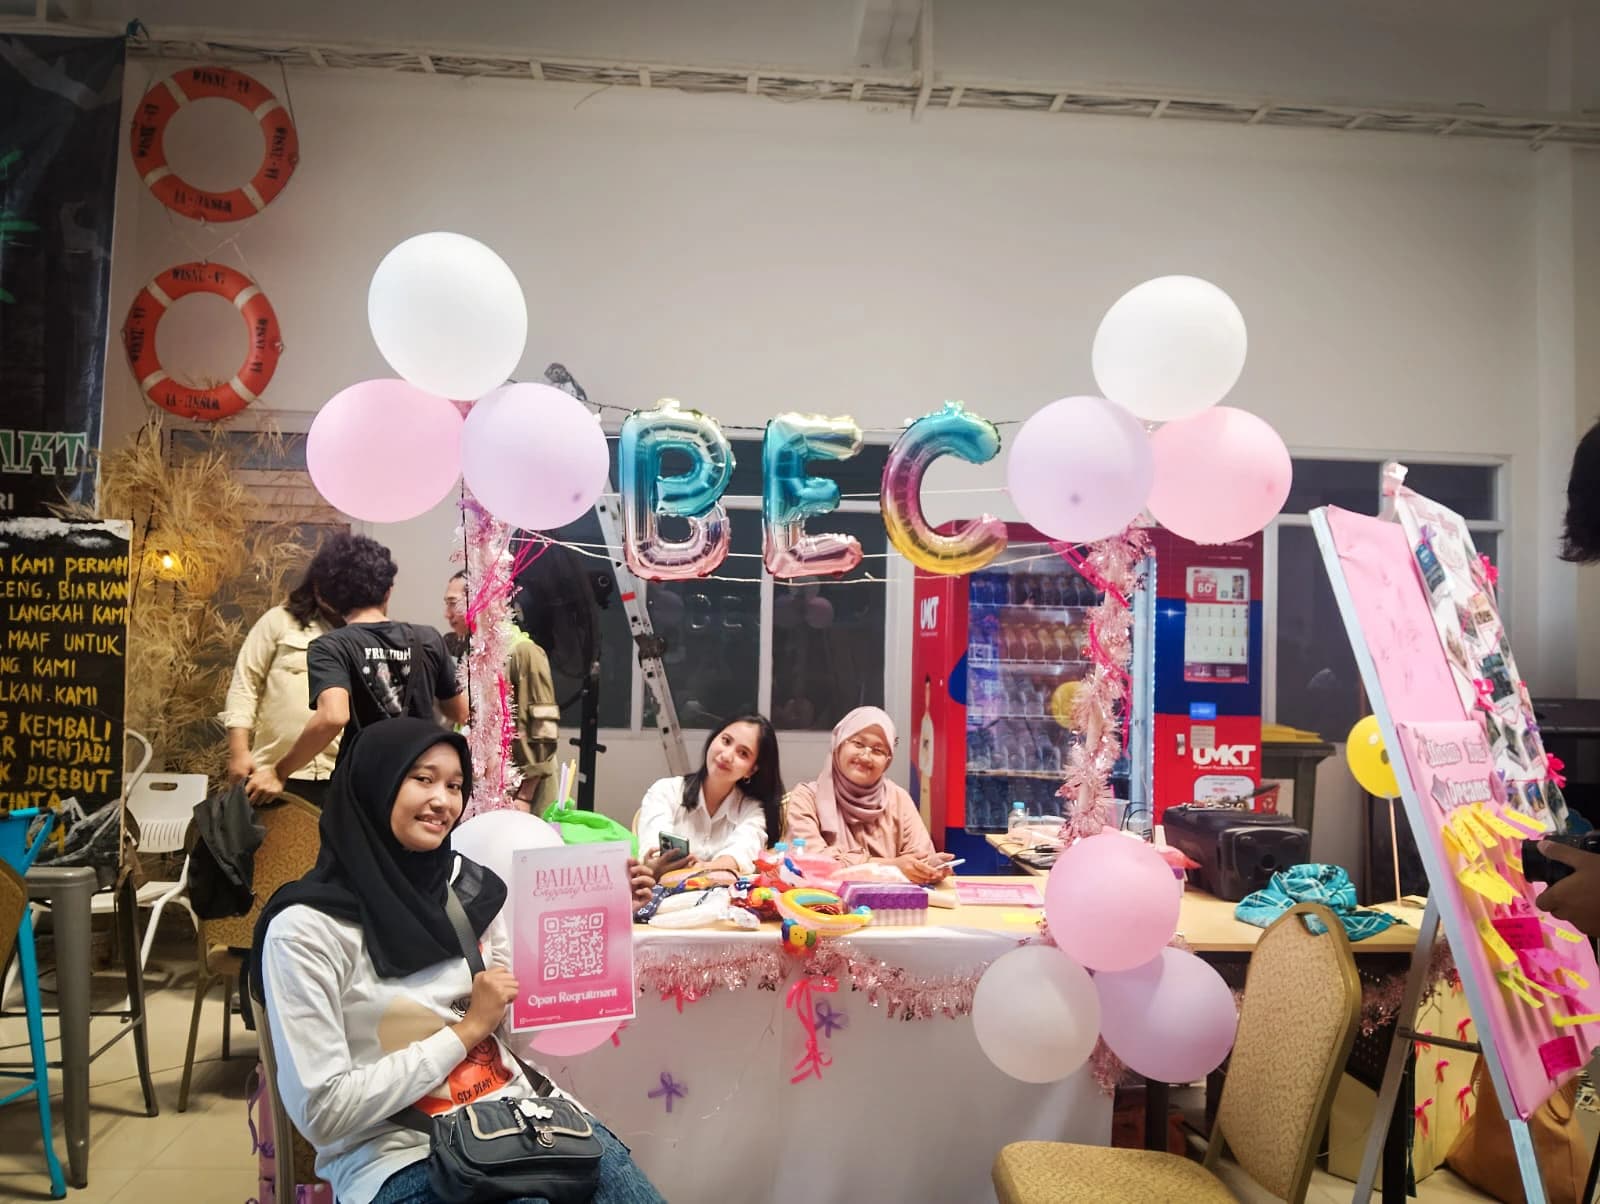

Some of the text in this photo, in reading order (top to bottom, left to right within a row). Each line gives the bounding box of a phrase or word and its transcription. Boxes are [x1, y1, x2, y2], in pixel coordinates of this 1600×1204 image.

[620, 399, 1008, 582] BEC
[11, 553, 55, 575] KAMI
[65, 555, 129, 581] PERNAH
[58, 580, 130, 601] BIARKAN
[9, 603, 84, 623] LANGKAH
[8, 630, 124, 656] MAAF UNTUK
[33, 656, 76, 678] KAMI
[55, 685, 98, 707] KAMI
[19, 712, 112, 741] KEMBALI
[31, 739, 111, 765] MENJADI
[1192, 744, 1256, 766] UMKT
[24, 765, 115, 793] DISEBUT
[536, 865, 612, 890] BAHANA
[527, 994, 556, 1008] Open
